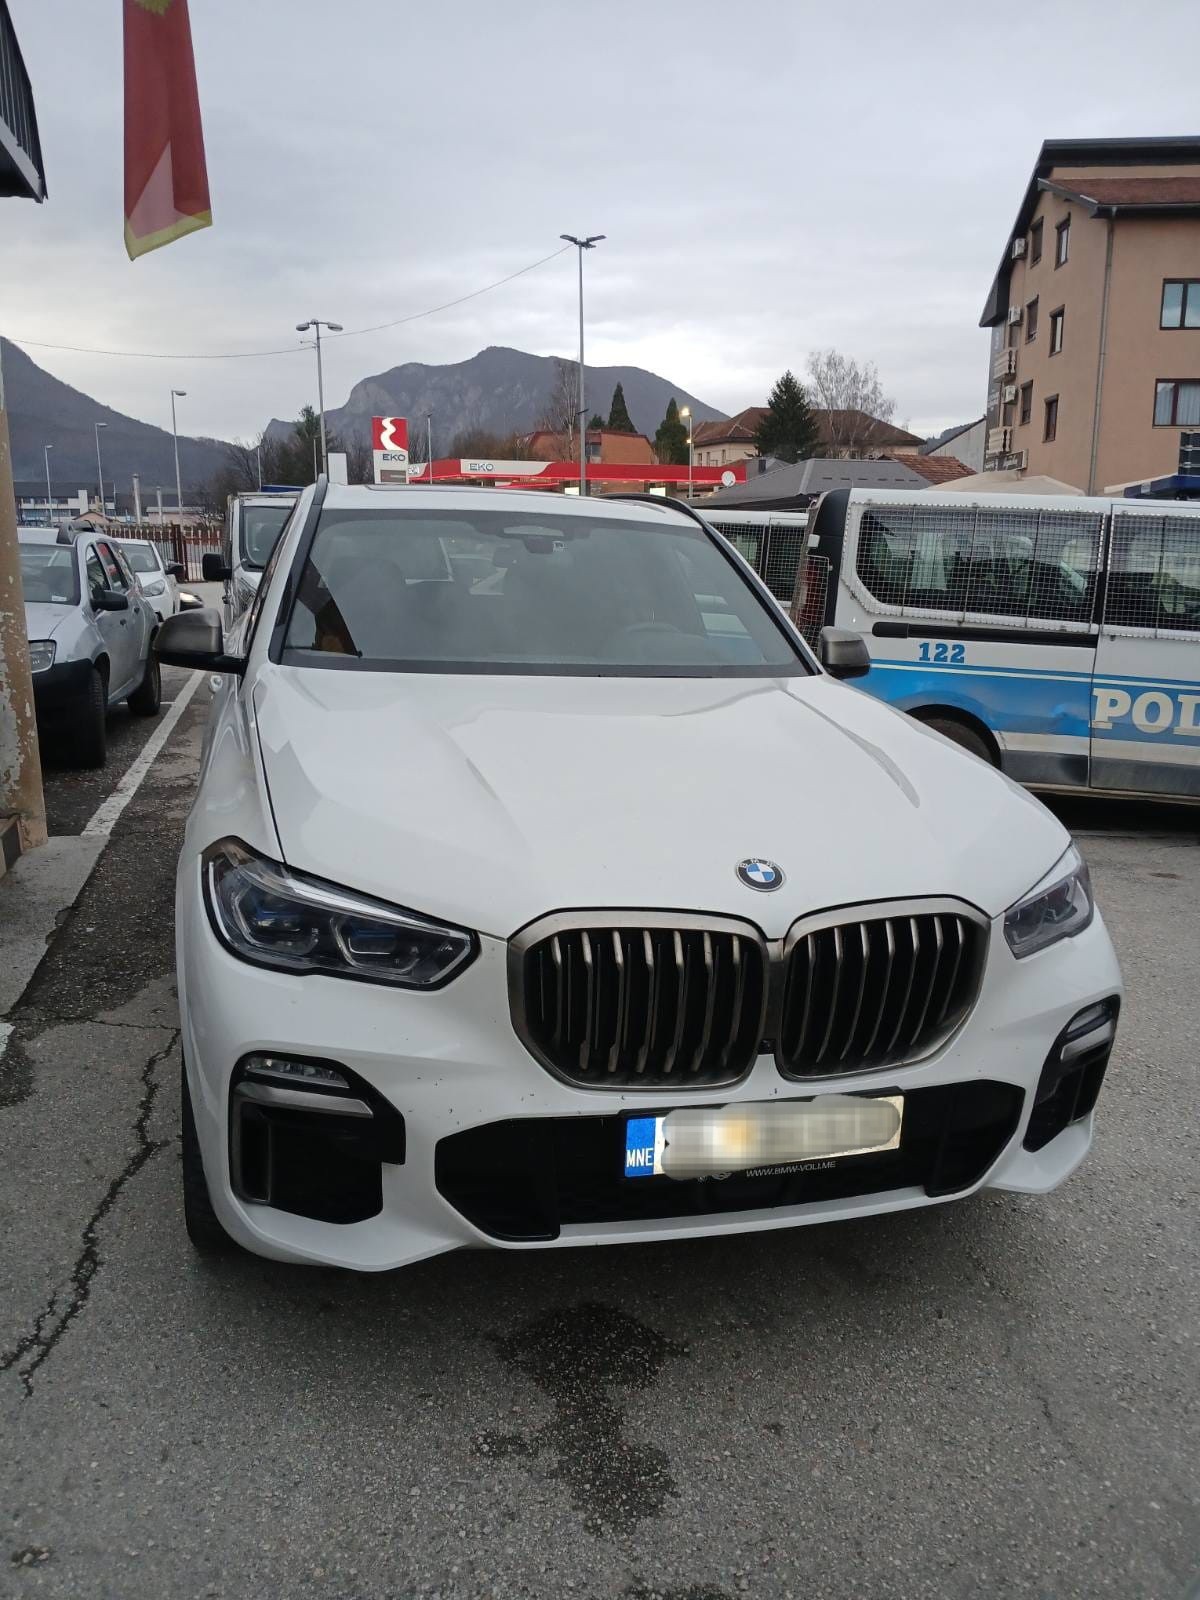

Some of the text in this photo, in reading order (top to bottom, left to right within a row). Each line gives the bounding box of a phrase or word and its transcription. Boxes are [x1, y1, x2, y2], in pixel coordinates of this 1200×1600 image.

[382, 453, 406, 462] EKO
[469, 463, 494, 472] EKO
[918, 642, 966, 664] 122
[1088, 688, 1200, 737] POL
[626, 1148, 654, 1168] MNE
